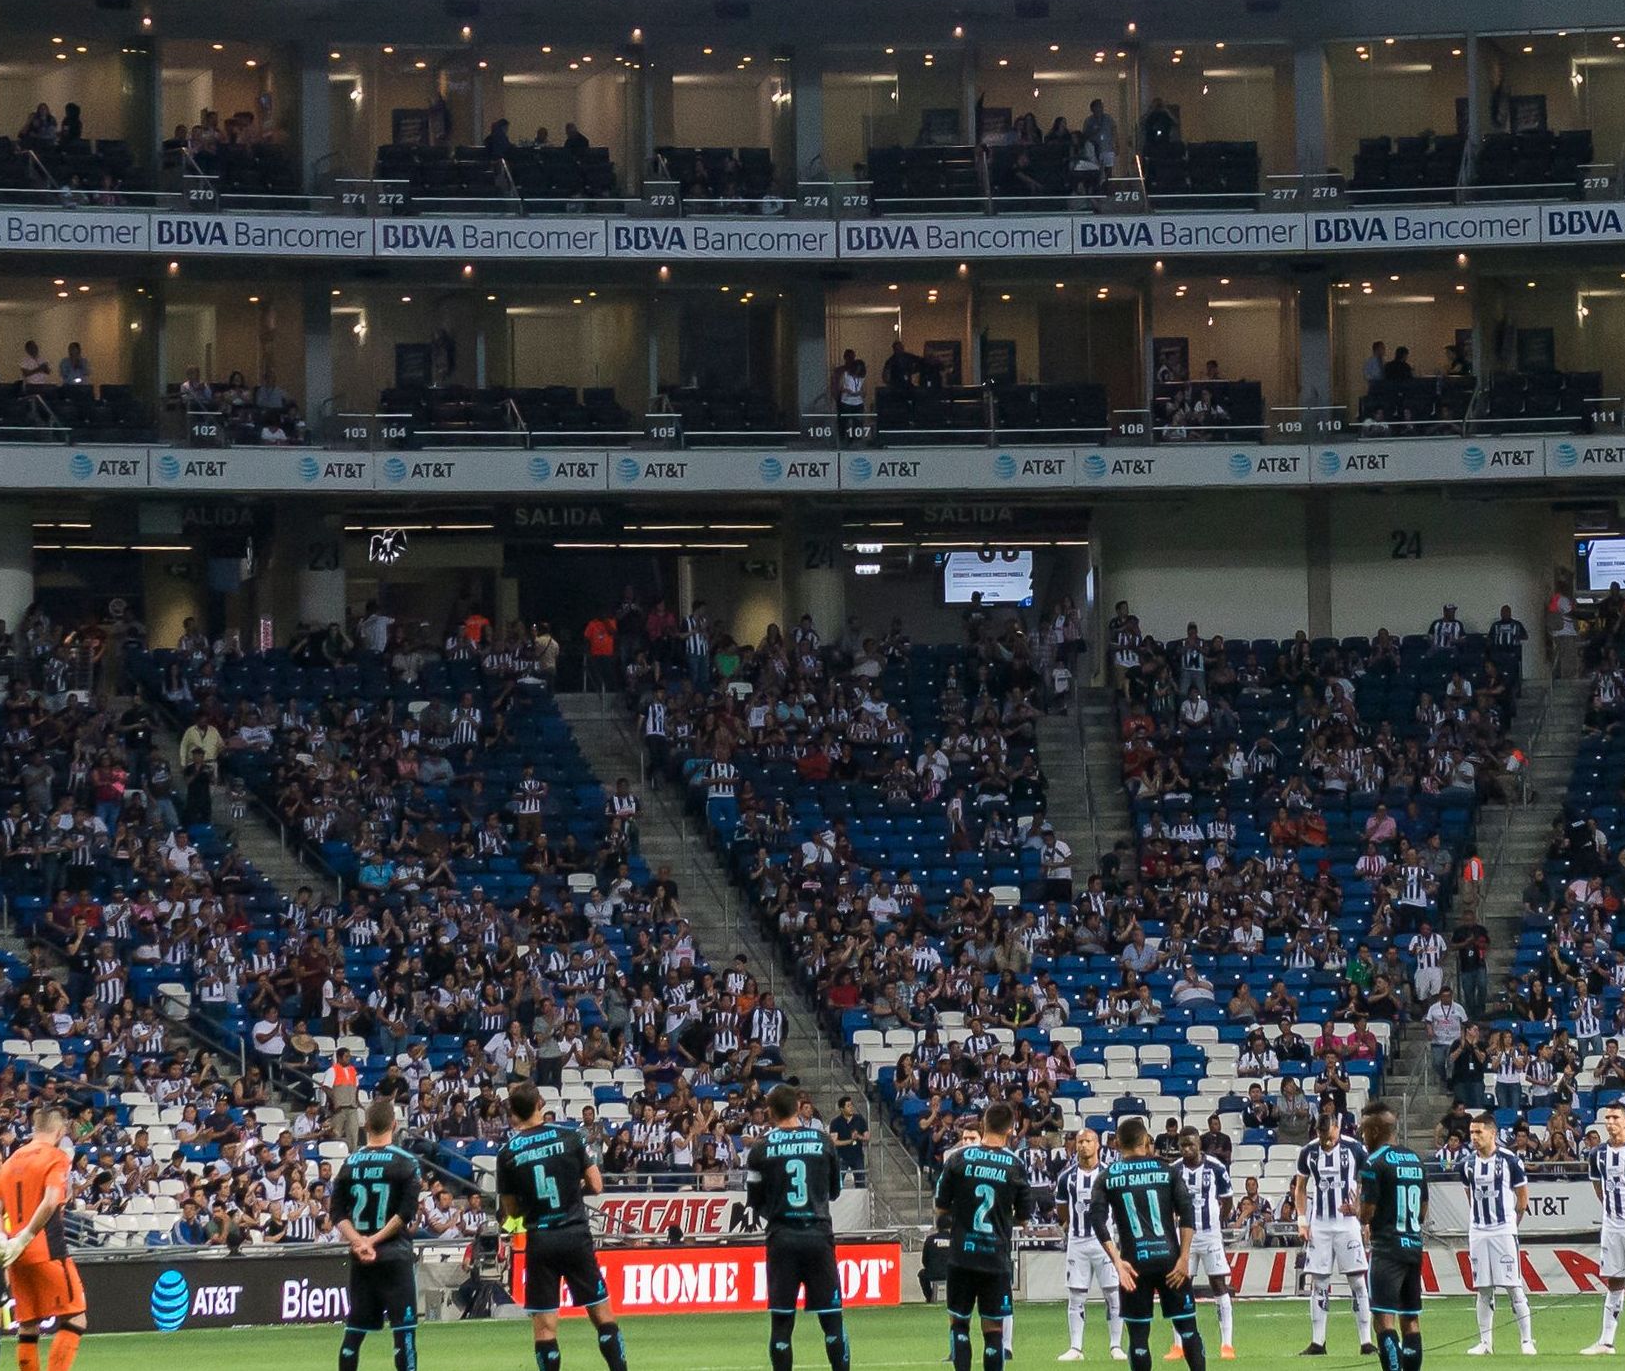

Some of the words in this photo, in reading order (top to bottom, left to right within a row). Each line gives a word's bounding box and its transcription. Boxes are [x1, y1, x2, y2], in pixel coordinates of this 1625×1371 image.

[190, 190, 214, 199] 270
[343, 194, 365, 203] 271
[379, 194, 403, 203] 272
[1273, 189, 1297, 199] 277
[1313, 188, 1337, 197] 278
[804, 197, 828, 206] 274
[8, 217, 141, 244] Bancomer
[158, 221, 228, 245] BBVA
[235, 222, 366, 248] Bancomer
[1081, 223, 1153, 247] BBVA
[1161, 222, 1297, 245] Bancomer
[1315, 218, 1387, 242] BBVA
[1395, 217, 1531, 240] Bancomer
[615, 227, 686, 250] BBVA
[694, 227, 828, 251] Bancomer
[382, 428, 405, 438] 104
[847, 427, 870, 437] 107
[1278, 422, 1302, 432] 109
[1257, 458, 1300, 472] AT&T
[1491, 451, 1534, 465] AT&T
[98, 461, 139, 475] AT&T
[324, 463, 365, 478] AT&T
[556, 463, 598, 477] AT&T
[787, 463, 830, 477] AT&T
[877, 462, 920, 476] AT&T
[515, 508, 603, 526] SALIDA
[1392, 531, 1422, 559] 24
[963, 1148, 1013, 1166] Corona
[975, 1167, 1007, 1182] CORRAL
[1108, 1159, 1160, 1175] Corona
[533, 1164, 560, 1209] 4
[785, 1159, 808, 1208] 3
[1128, 1173, 1169, 1186] SANCHEZ
[352, 1183, 390, 1230] 27
[973, 1184, 995, 1234] 2
[1122, 1189, 1165, 1239] 11
[1396, 1185, 1421, 1233] 19
[601, 1199, 729, 1233] TECATE
[622, 1262, 740, 1306] HOME
[192, 1285, 239, 1316] AT&T
